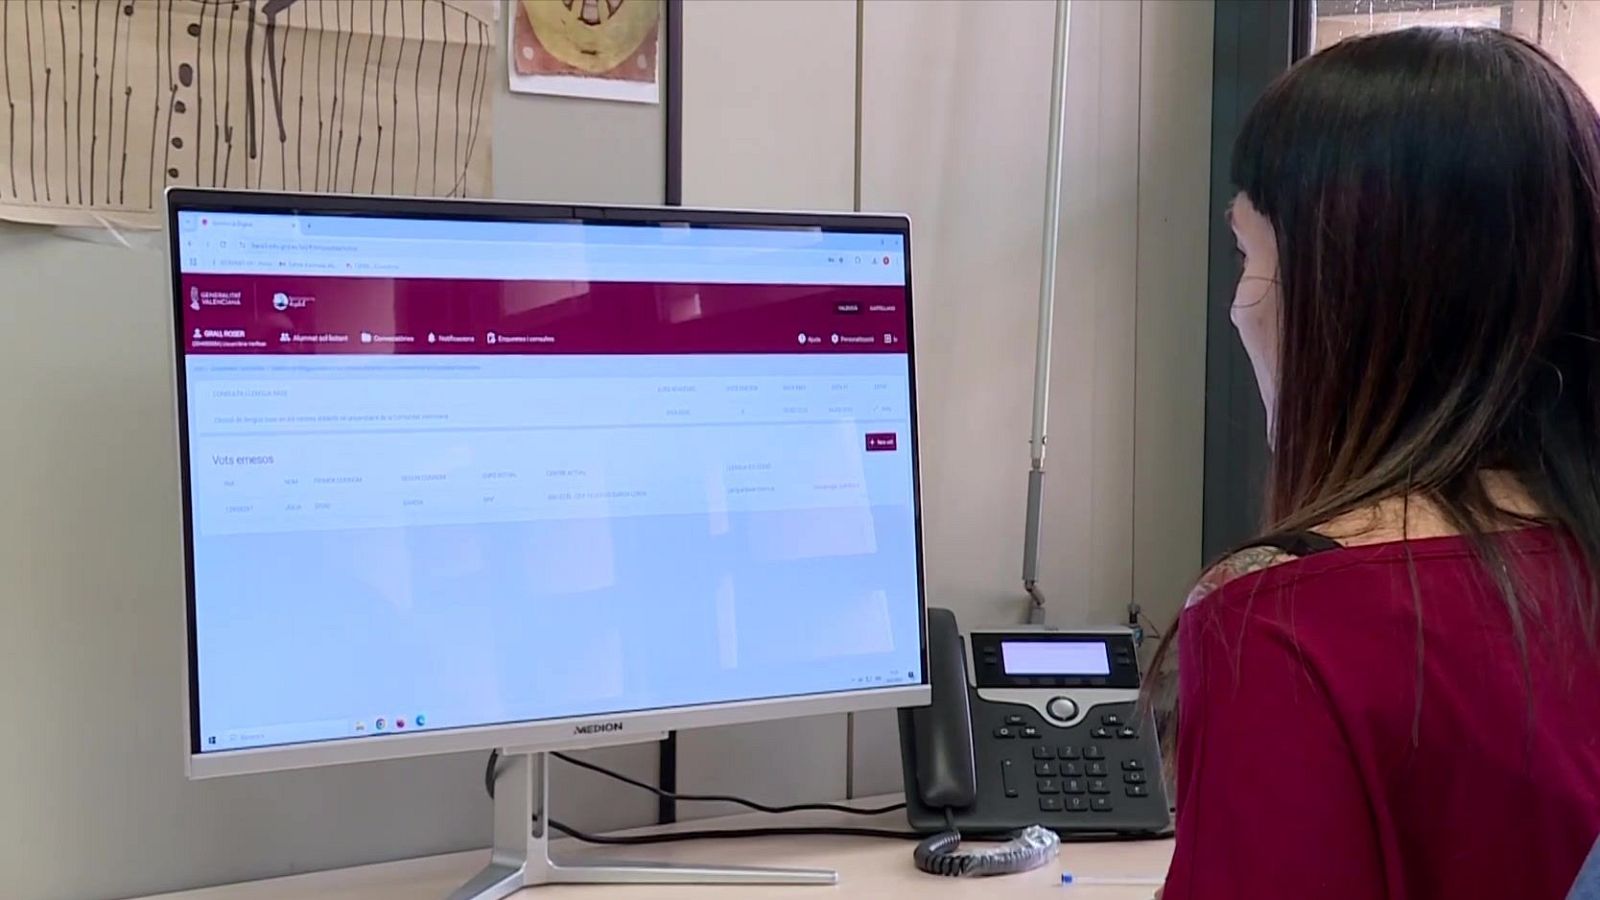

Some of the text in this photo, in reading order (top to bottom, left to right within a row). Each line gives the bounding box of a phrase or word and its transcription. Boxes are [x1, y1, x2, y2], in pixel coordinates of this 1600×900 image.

[200, 291, 242, 299] GENERALITAT
[201, 298, 241, 306] VALENCIANA
[211, 454, 275, 466] Vots emesos
[575, 721, 623, 734] MEDION
